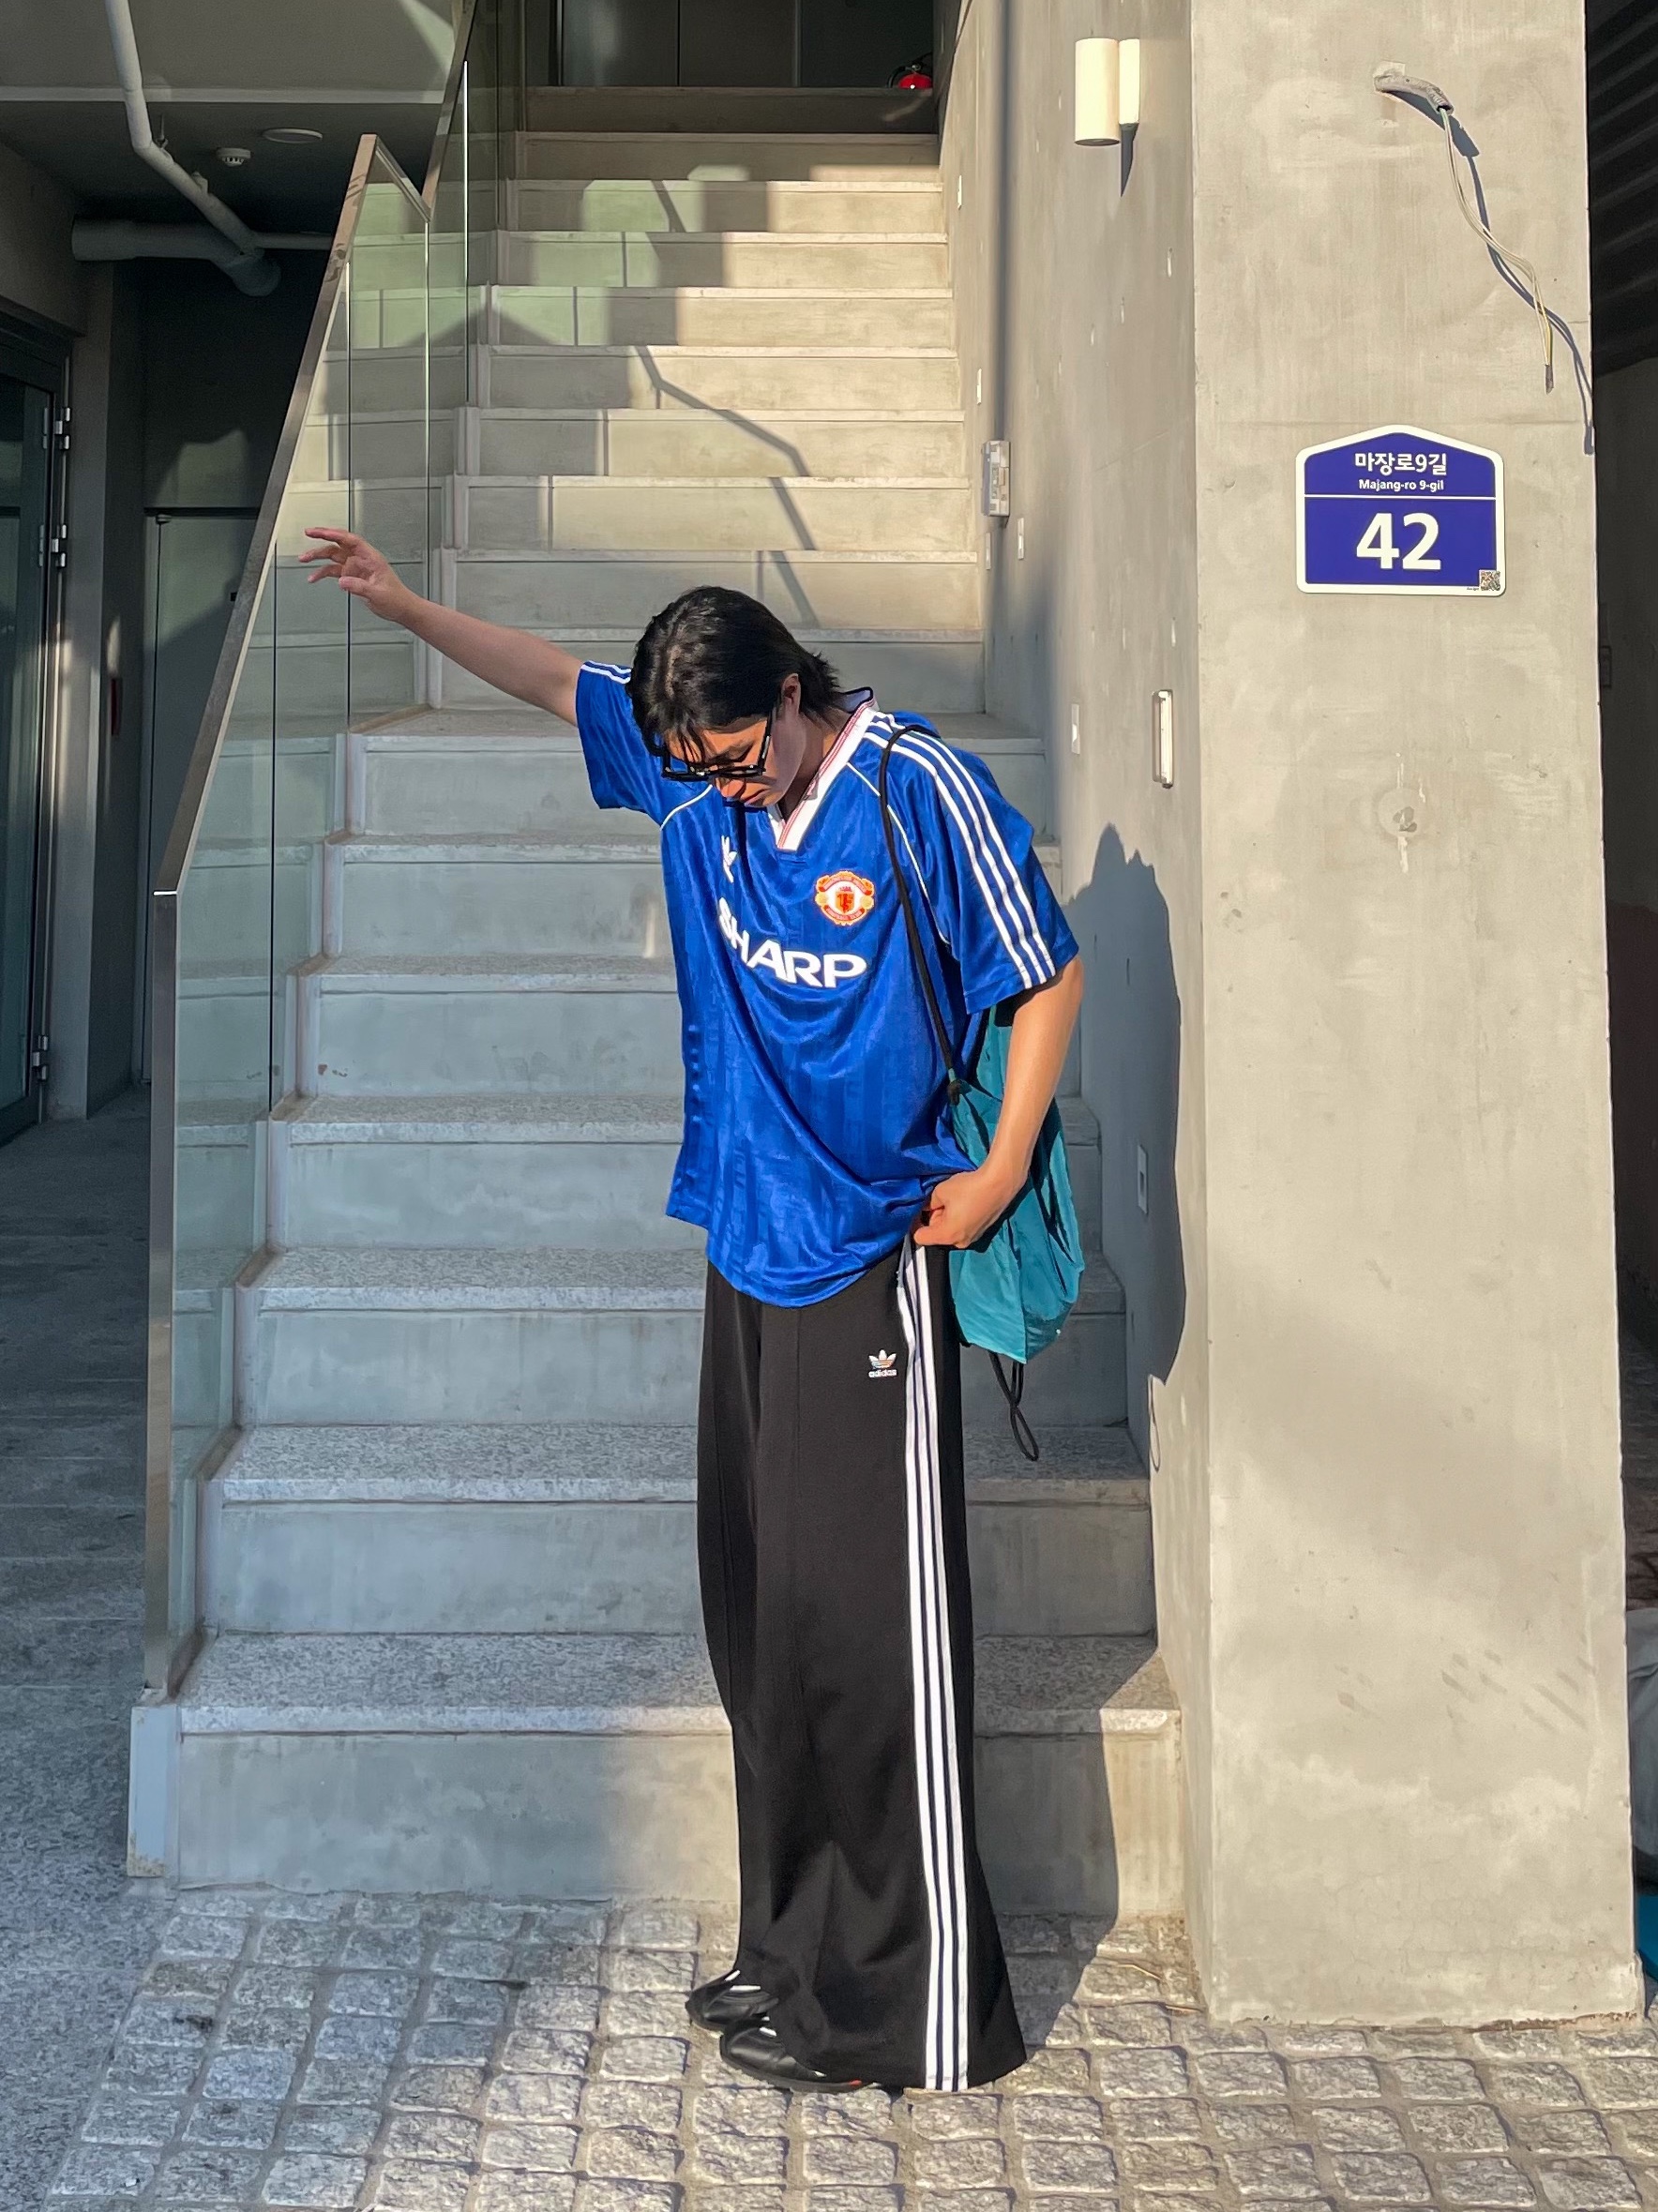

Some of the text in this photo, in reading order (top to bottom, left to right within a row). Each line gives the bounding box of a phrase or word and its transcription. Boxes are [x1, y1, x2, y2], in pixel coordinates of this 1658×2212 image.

[1355, 452, 1447, 475] 마장로9길
[1359, 479, 1444, 492] Majang-ro 9-gil
[1356, 513, 1441, 570] 42
[718, 896, 867, 988] SHARP
[868, 1368, 897, 1378] adidas
